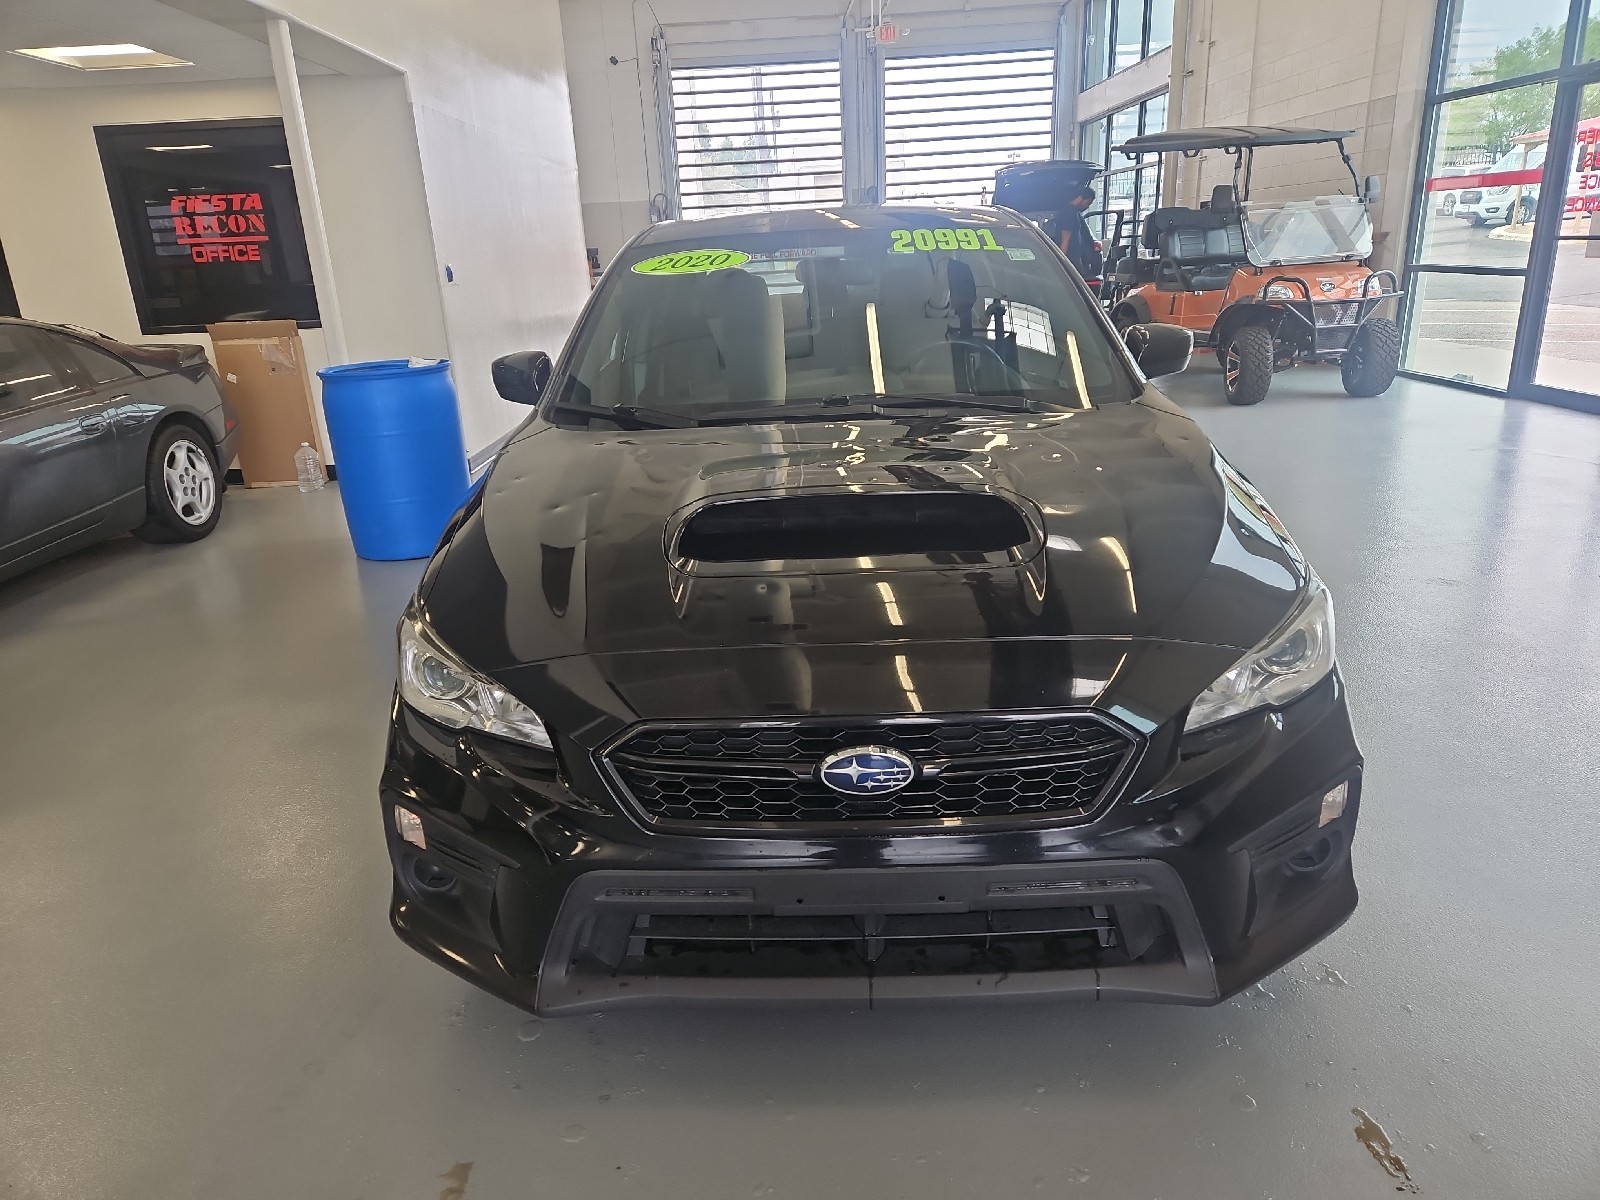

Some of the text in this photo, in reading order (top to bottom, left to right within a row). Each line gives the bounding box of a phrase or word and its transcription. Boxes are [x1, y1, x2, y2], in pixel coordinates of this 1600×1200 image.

[879, 26, 896, 41] EXIT
[170, 192, 263, 214] FIESTA
[172, 213, 266, 235] RECON
[890, 228, 1004, 252] 20991
[191, 244, 261, 263] OFFICE
[649, 253, 732, 272] 2020
